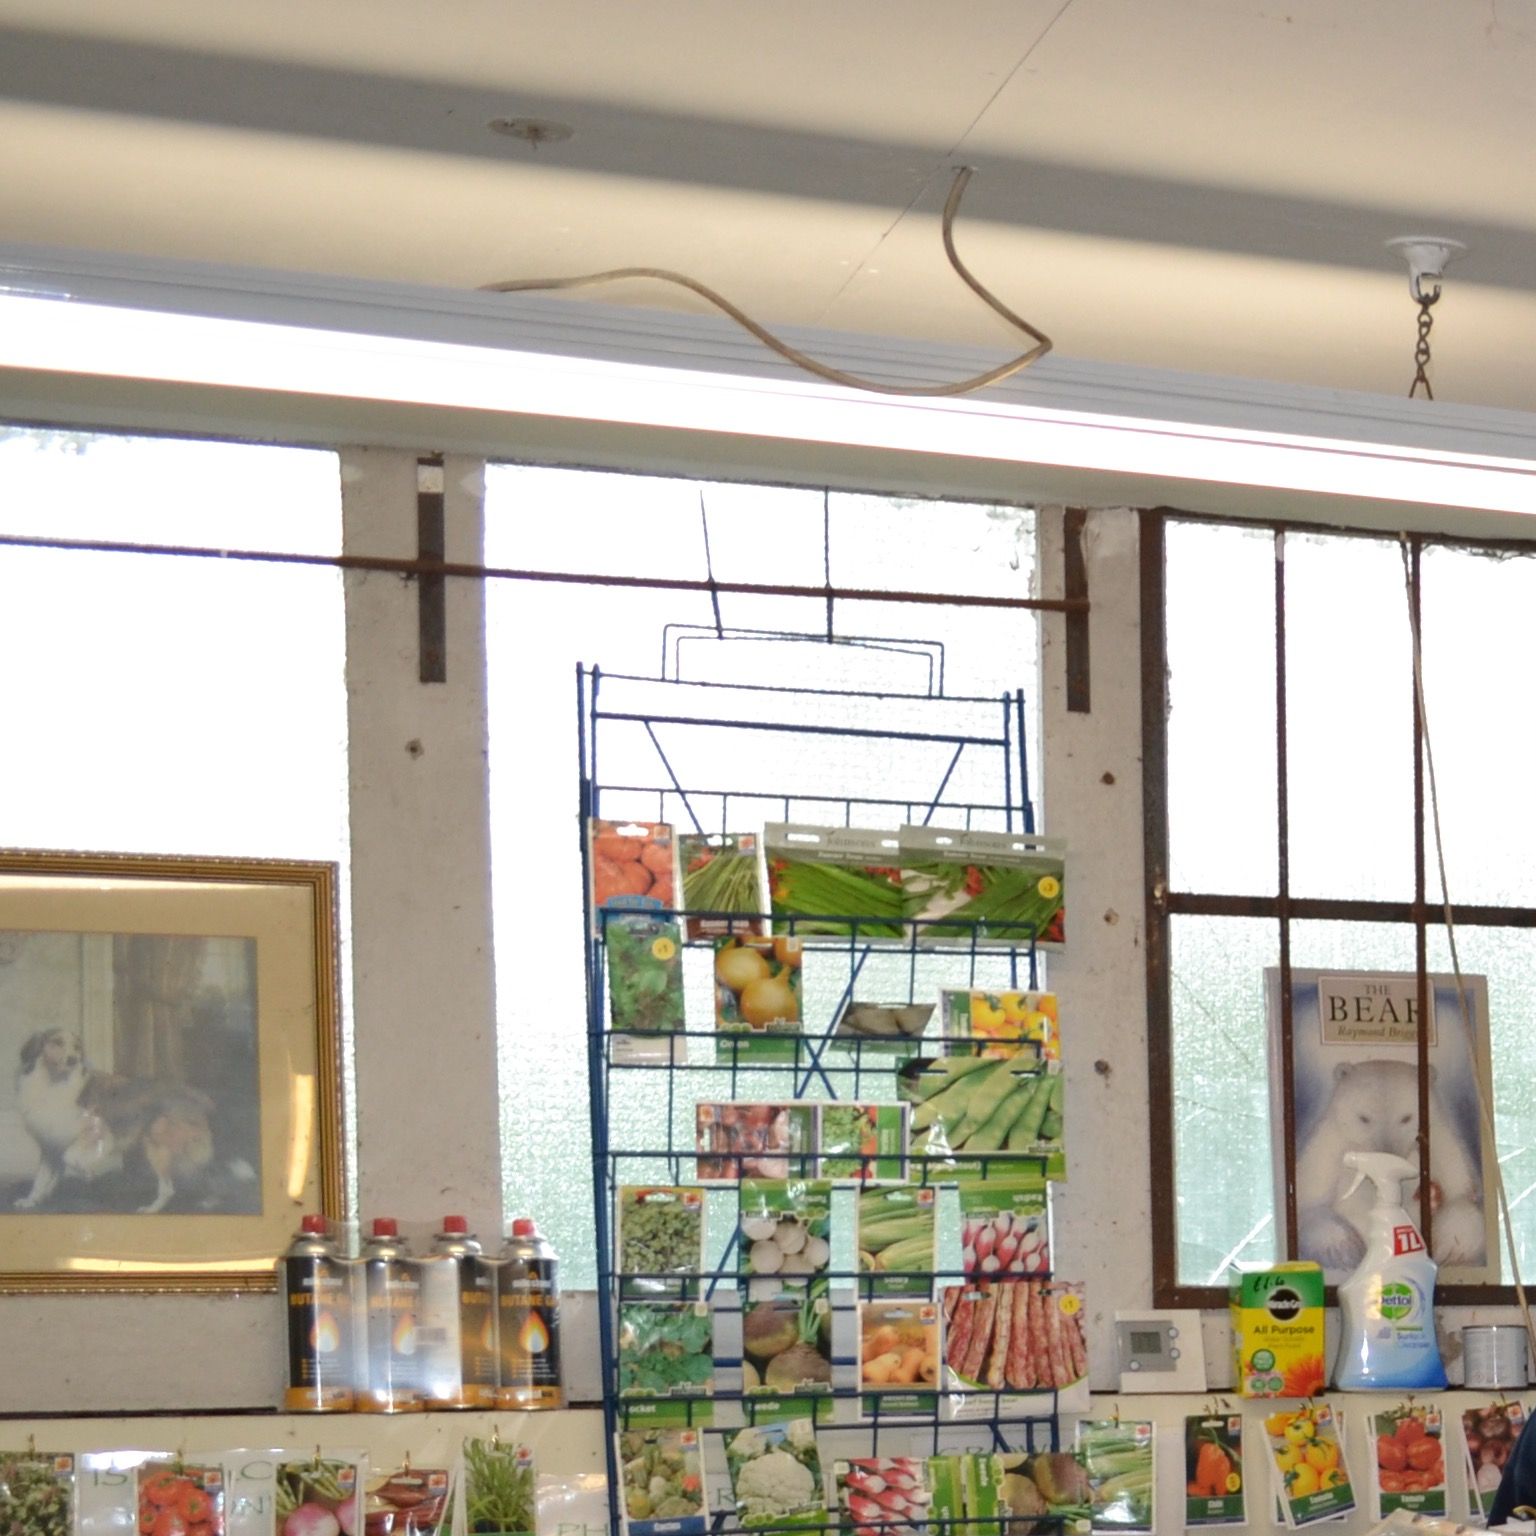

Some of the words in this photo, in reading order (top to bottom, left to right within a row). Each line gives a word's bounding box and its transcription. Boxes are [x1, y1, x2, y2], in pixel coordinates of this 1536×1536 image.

[1363, 984, 1391, 996] THE
[1254, 1324, 1269, 1336] All
[1270, 1324, 1315, 1337] Purpose
